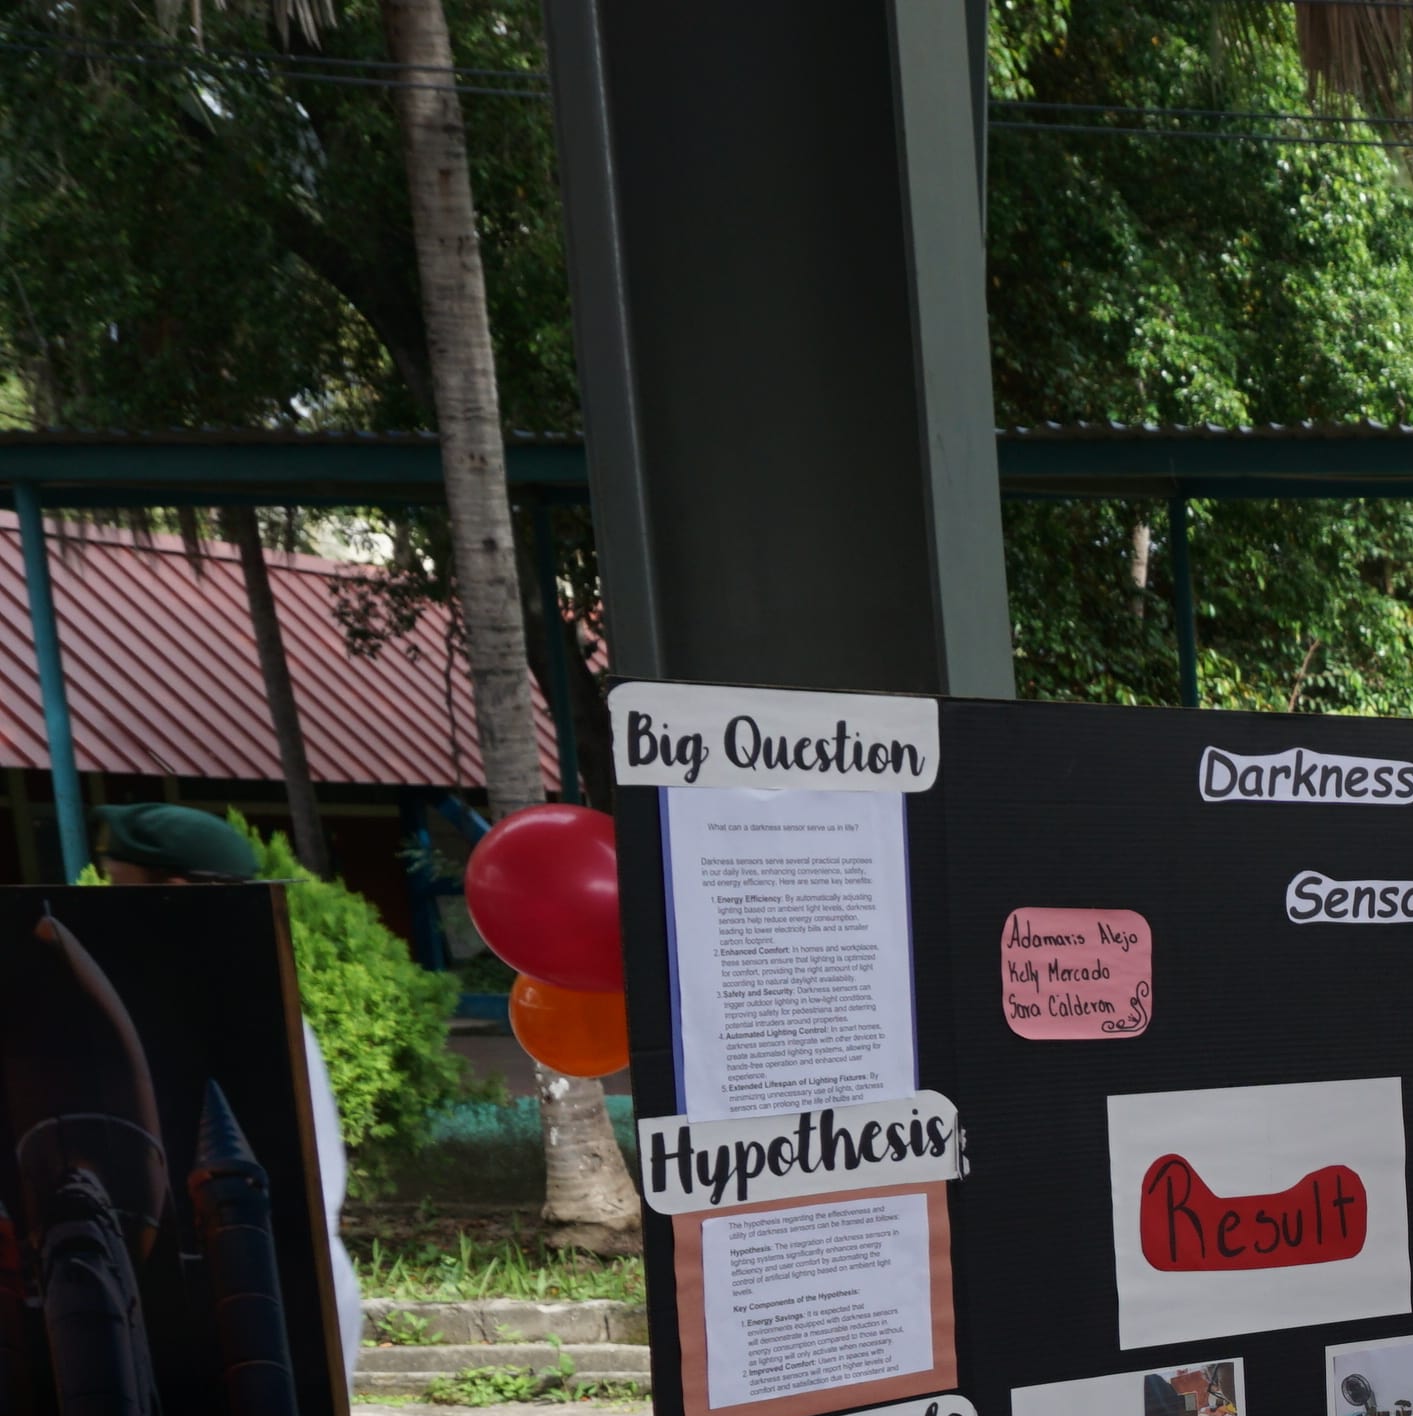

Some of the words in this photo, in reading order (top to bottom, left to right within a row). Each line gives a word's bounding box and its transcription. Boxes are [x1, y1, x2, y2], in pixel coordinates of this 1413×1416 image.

[628, 711, 709, 783] Big
[723, 715, 925, 776] Question
[717, 895, 743, 905] Energy
[1007, 914, 1085, 948] Adamaris
[1097, 921, 1138, 952] Alejo
[720, 947, 757, 956] Enhanced
[1008, 960, 1039, 993] Kelly
[1048, 958, 1110, 982] Mercado
[723, 990, 746, 999] Safety
[747, 988, 761, 997] and
[1009, 993, 1041, 1019] Sara
[726, 1029, 766, 1039] Automated
[767, 1027, 797, 1039] Lighting
[728, 1081, 762, 1092] Extended
[764, 1080, 796, 1089] Lifespan
[798, 1077, 805, 1086] of
[808, 1075, 838, 1086] Lighting
[651, 1108, 952, 1205] Hypothesis
[1148, 1160, 1355, 1262] Result
